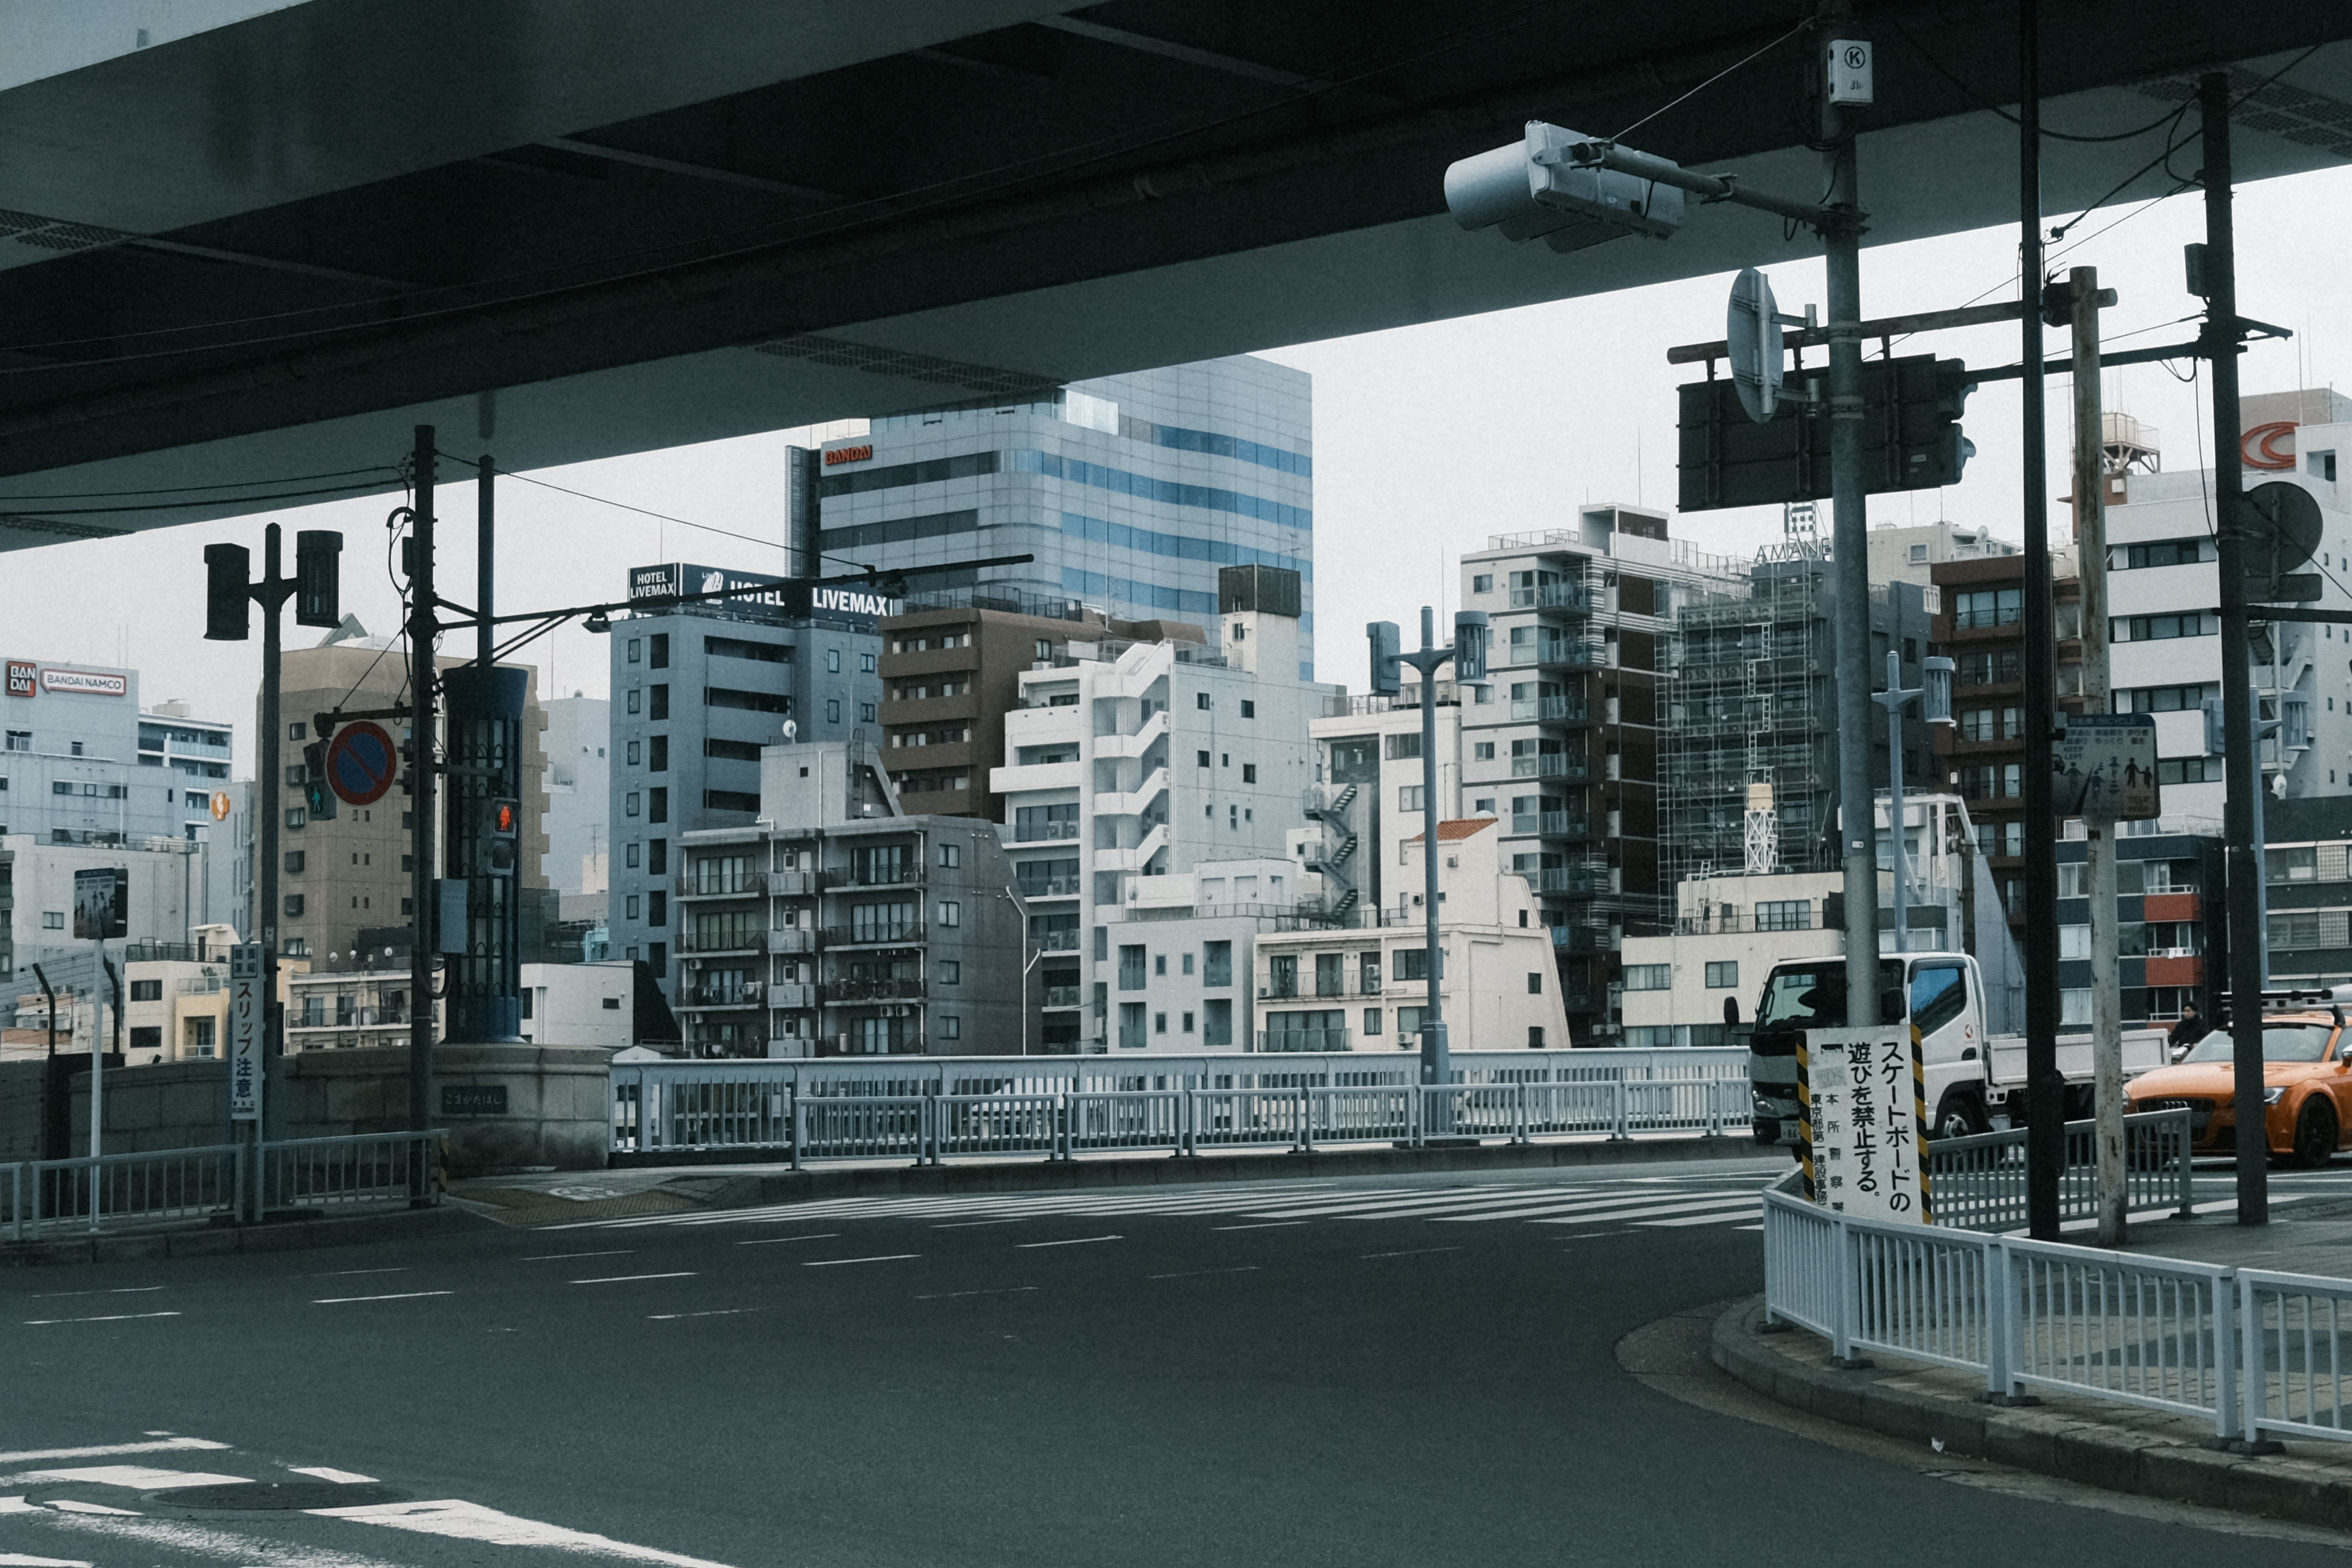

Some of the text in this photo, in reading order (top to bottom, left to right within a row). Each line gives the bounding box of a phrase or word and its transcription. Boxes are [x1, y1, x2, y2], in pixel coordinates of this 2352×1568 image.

[825, 445, 873, 466] BANDAI
[637, 571, 667, 585] HOTEL
[630, 583, 674, 599] LIVEMAX
[812, 587, 887, 617] LIVEMAX
[11, 666, 35, 679] BAN
[11, 679, 30, 691] DAI
[47, 674, 121, 689] BANDAI NAMCO
[236, 982, 253, 1098] スリップ注意
[1881, 1042, 1911, 1212] スケートボードの
